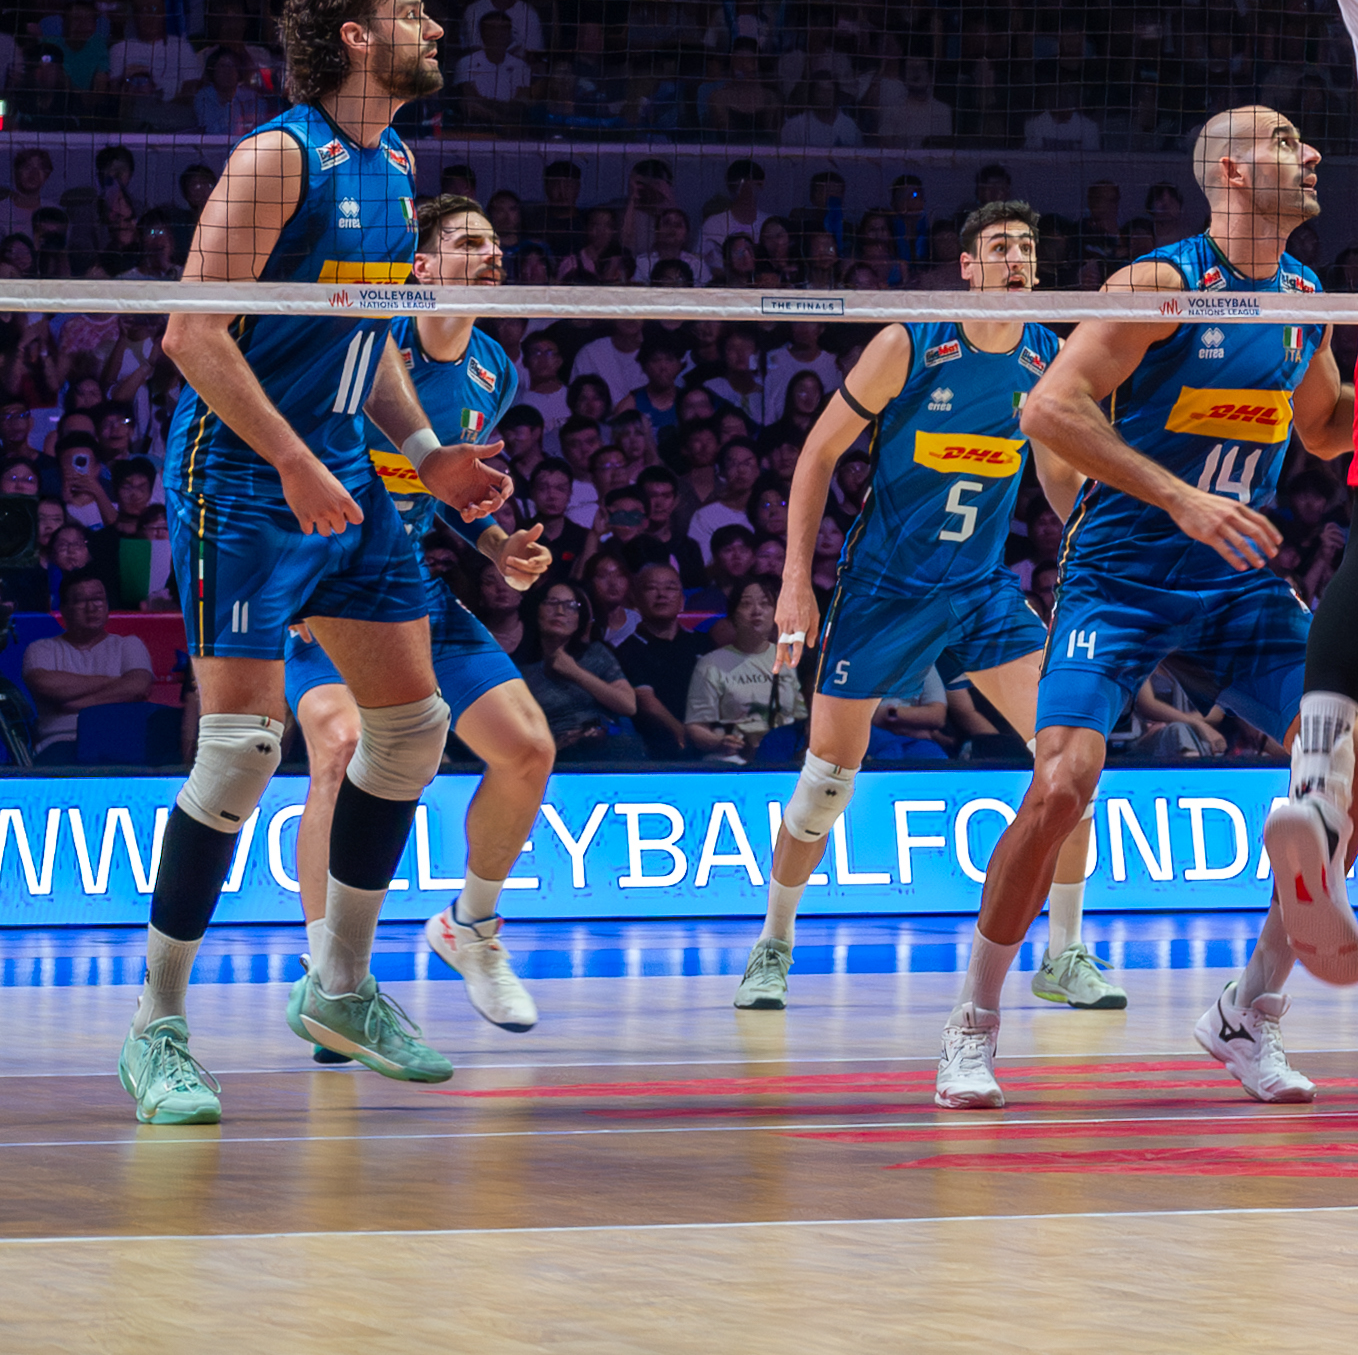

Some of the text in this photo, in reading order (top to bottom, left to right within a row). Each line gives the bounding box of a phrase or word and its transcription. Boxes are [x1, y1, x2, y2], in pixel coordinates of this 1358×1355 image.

[328, 289, 354, 307] VNL
[359, 290, 437, 301] VOLLEYBALL
[1187, 297, 1260, 309] VOLLEYBALL
[359, 301, 437, 309] NATIONS LEAGUE
[770, 301, 835, 311] THE FINALS
[1159, 298, 1184, 316] VNL
[1198, 347, 1225, 360] errea
[1285, 348, 1302, 363] ITA
[332, 330, 376, 415] 11
[927, 401, 952, 412] errea
[1208, 404, 1280, 426] DHL
[942, 446, 1006, 465] DHL
[1197, 443, 1263, 505] 14
[938, 480, 984, 543] 5
[232, 601, 249, 633] 11
[1067, 629, 1096, 660] 14
[833, 659, 851, 685] 5
